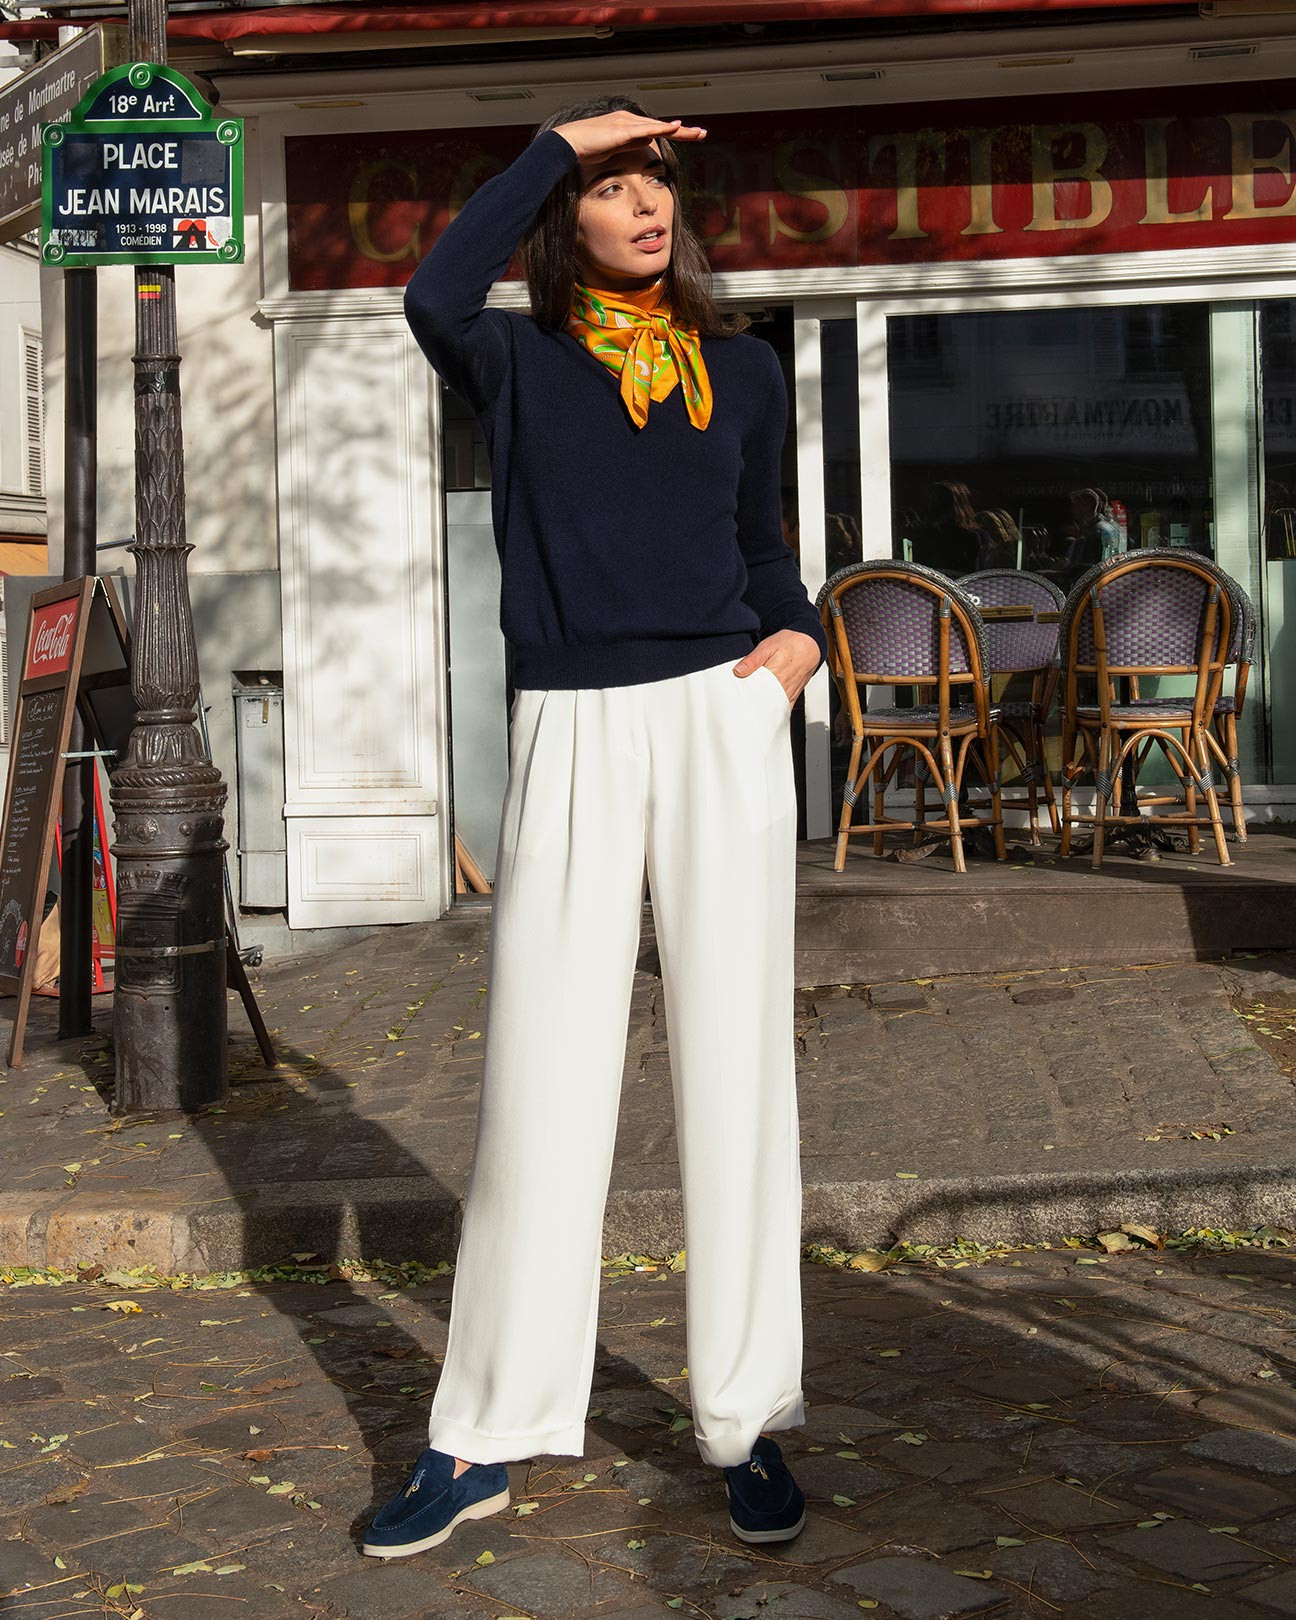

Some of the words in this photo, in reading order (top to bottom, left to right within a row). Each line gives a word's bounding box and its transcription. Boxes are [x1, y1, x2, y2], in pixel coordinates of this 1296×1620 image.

[14, 99, 24, 124] de
[28, 70, 76, 115] Montmartre
[108, 95, 137, 114] 18e
[18, 132, 28, 158] de
[103, 143, 178, 169] PLACE
[59, 189, 120, 215] JEAN
[130, 187, 225, 214] MARAIS
[115, 224, 137, 234] 1913
[145, 223, 167, 233] 1998
[120, 234, 162, 246] COMÉDIEN
